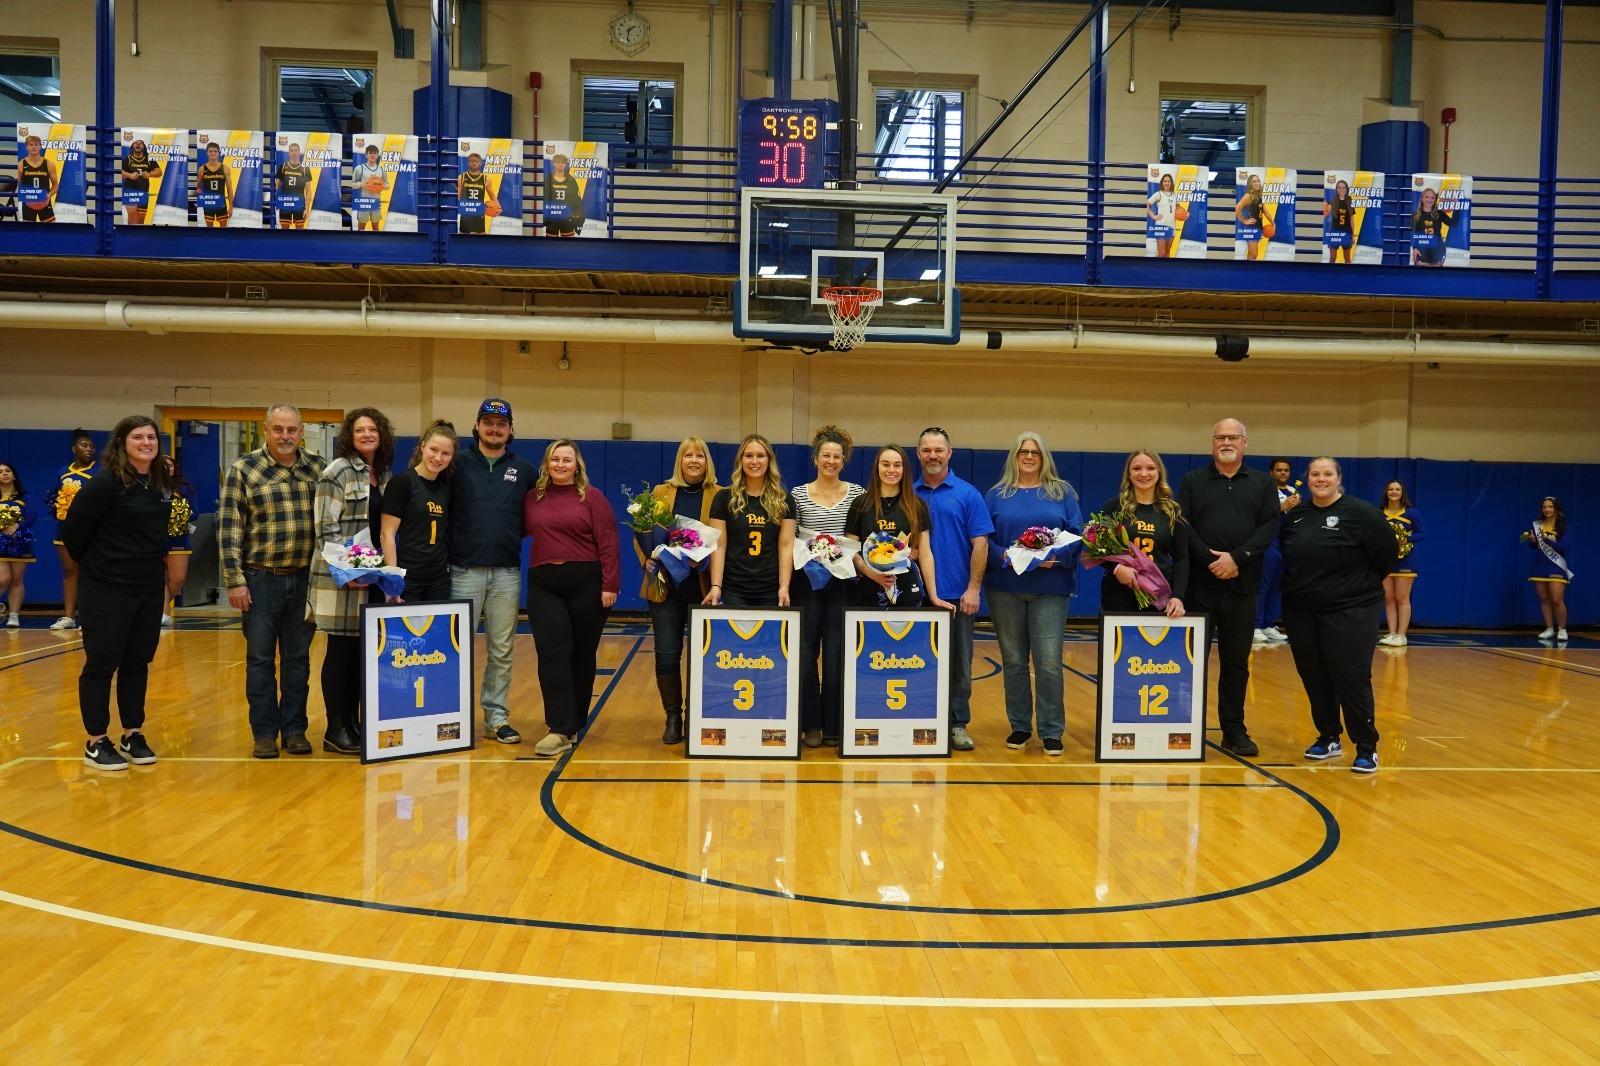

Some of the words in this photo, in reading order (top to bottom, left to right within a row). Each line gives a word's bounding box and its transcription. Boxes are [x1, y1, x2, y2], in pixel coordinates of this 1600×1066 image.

[763, 115, 817, 140] 9:58
[41, 140, 84, 150] JACKSON
[146, 144, 181, 155] JOZIAH
[57, 152, 79, 161] BYER
[220, 147, 260, 157] MICHAEL
[306, 149, 333, 160] RYAN
[381, 151, 401, 162] BEN
[232, 159, 261, 168] BIGELY
[301, 160, 342, 168] GREGGERSON
[485, 155, 512, 166] MATT
[568, 158, 599, 168] TRENT
[760, 142, 806, 183] 30
[383, 163, 417, 172] THOMAS
[573, 170, 603, 179] ROZICH
[210, 180, 219, 191] 13
[288, 176, 297, 186] 21
[1177, 181, 1203, 191] ABBY
[1262, 183, 1291, 193] LAURA
[1348, 187, 1382, 197] PHOEBE
[468, 189, 479, 199] 32
[555, 190, 565, 200] 33
[1176, 193, 1206, 202] HENISE
[1261, 195, 1295, 204] VITTONE
[1439, 190, 1465, 199] ANNA
[1350, 199, 1382, 208] SNYDER
[1437, 201, 1470, 210] DURBIN
[1339, 215, 1345, 225] 5
[426, 501, 444, 514] Pitt
[745, 513, 766, 525] Pitt
[877, 519, 897, 530] Pitt
[1135, 520, 1156, 532] Pitt
[429, 519, 437, 545] 1
[748, 531, 762, 556] 3
[391, 648, 447, 668] Bobcats
[715, 649, 775, 670] Bobcats
[869, 650, 926, 670] Bobcats
[1127, 656, 1181, 676] Bobcats
[413, 676, 424, 708] 1
[733, 679, 755, 711] 3
[886, 679, 907, 710] 5
[1138, 684, 1169, 716] 12
